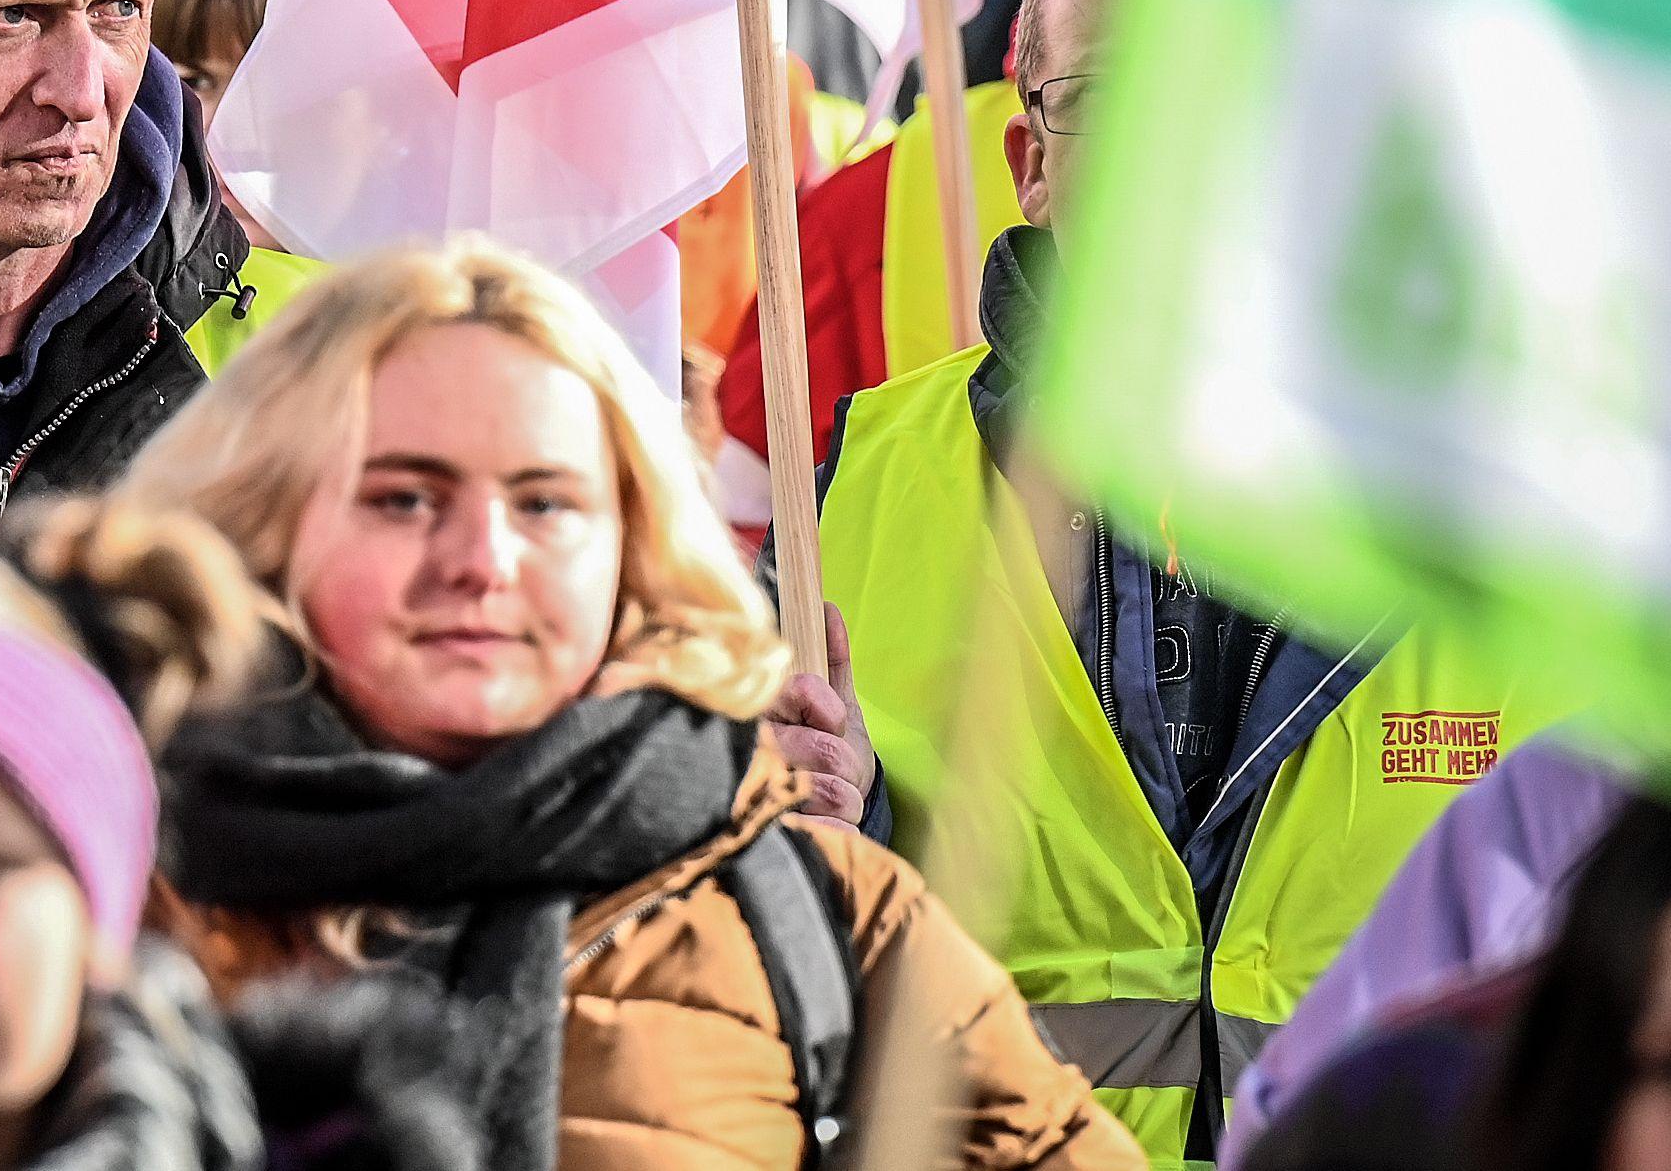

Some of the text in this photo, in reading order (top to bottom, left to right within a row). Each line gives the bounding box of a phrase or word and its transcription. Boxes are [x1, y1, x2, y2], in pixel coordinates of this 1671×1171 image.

[1381, 719, 1500, 746] ZUSAMMEN
[1381, 748, 1498, 775] GEHT MEHR
